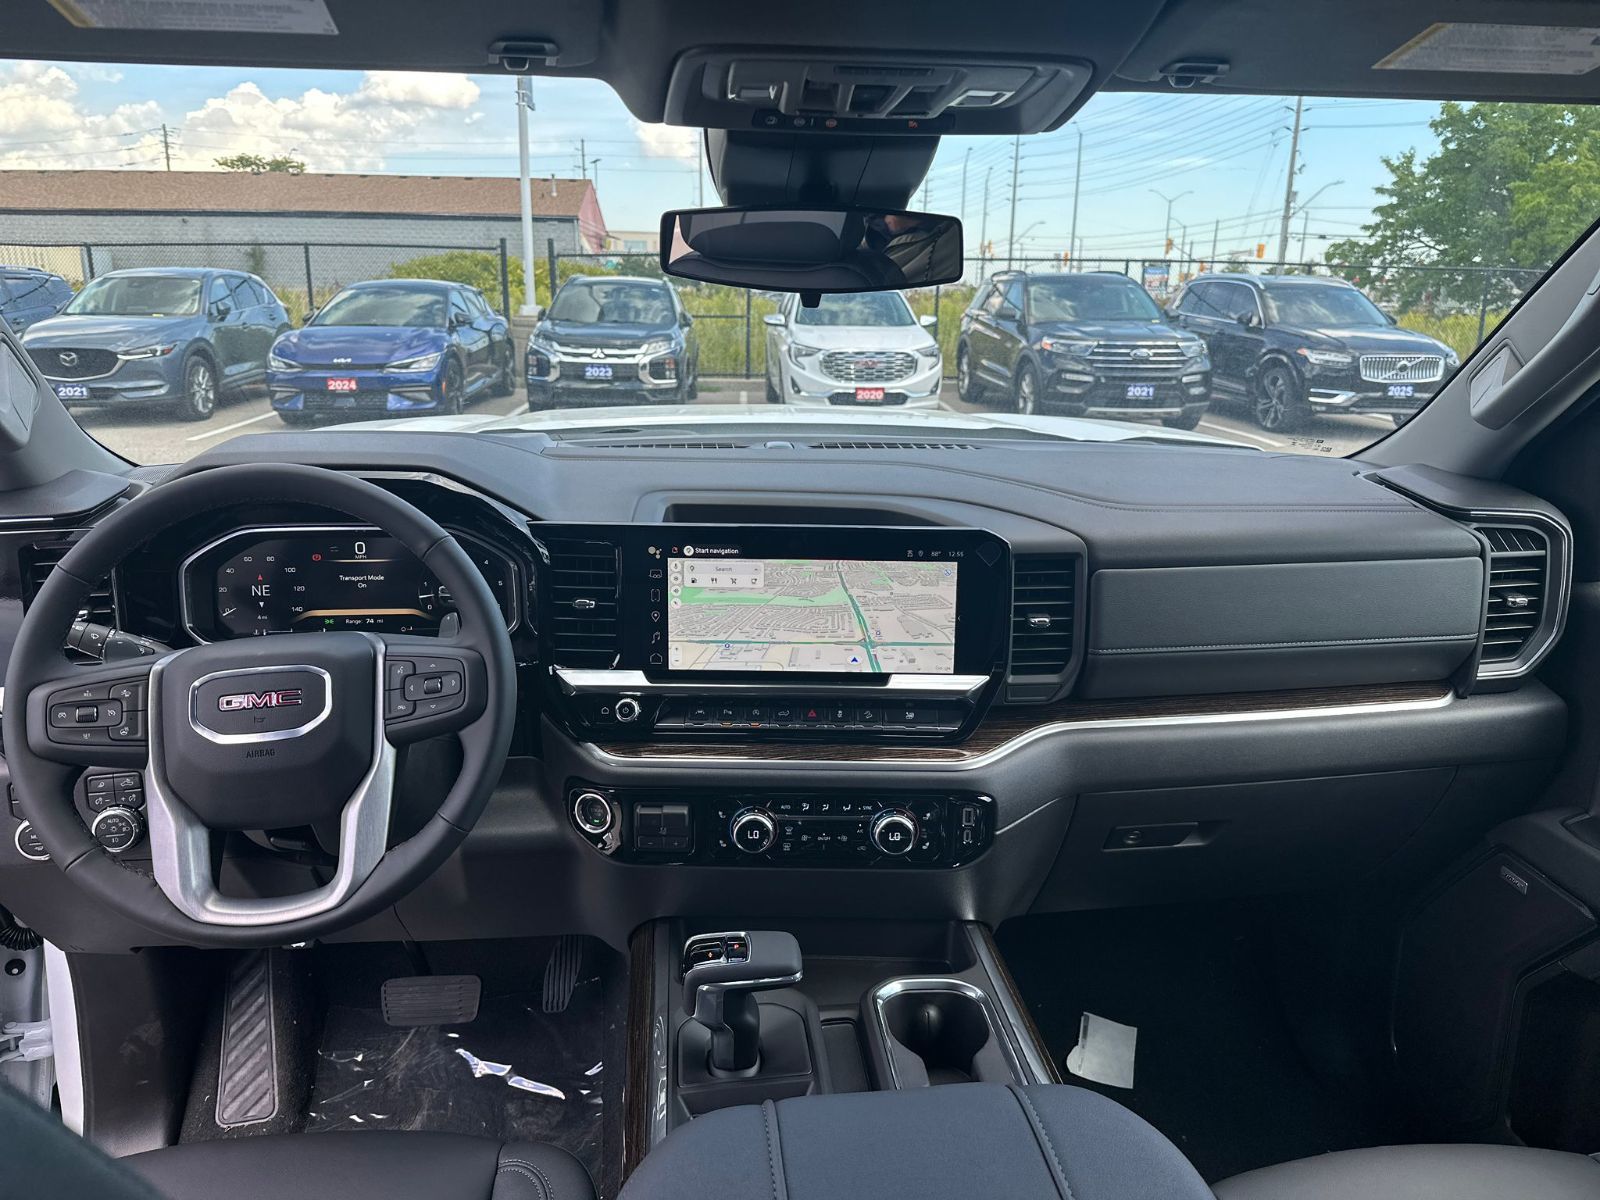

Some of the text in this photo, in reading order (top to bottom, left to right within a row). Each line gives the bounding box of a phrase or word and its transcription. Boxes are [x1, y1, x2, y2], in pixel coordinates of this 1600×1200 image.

[585, 367, 613, 377] 2023
[327, 380, 357, 390] 2024
[58, 386, 88, 396] 2021
[856, 390, 884, 400] 2020
[1127, 386, 1154, 396] 2021
[1387, 386, 1413, 396] 2025
[354, 541, 366, 555] 0
[710, 547, 739, 555] navigation
[251, 584, 271, 597] NE
[219, 690, 302, 711] GMC
[246, 749, 276, 759] AIRBAG
[747, 830, 760, 839] LO
[888, 832, 901, 841] LO
